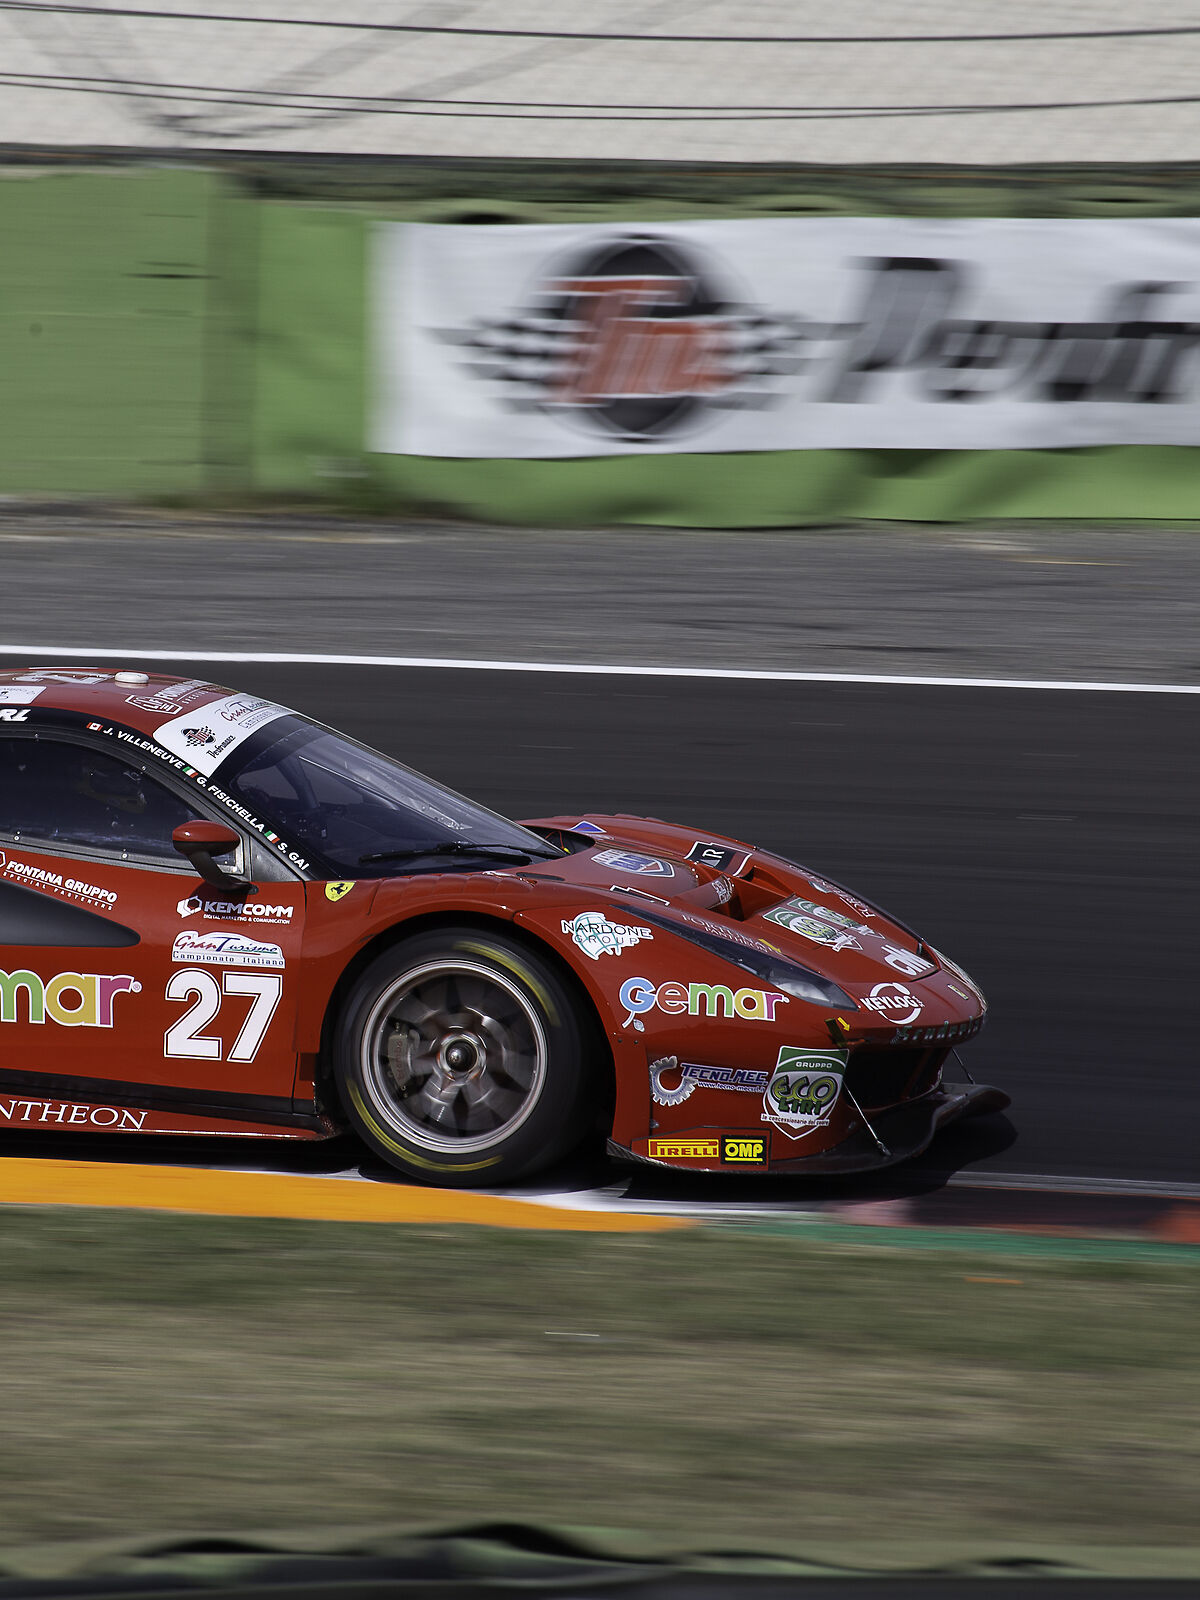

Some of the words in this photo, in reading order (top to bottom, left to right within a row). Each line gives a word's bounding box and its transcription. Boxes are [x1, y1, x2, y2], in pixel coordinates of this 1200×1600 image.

[103, 727, 114, 736] J.
[117, 730, 185, 769] VILLENEUVE
[196, 776, 207, 787] G.
[207, 785, 265, 832] FISICHELLA
[277, 842, 288, 853] S.
[288, 852, 310, 871] GAI
[6, 861, 63, 886] FONTANA
[64, 878, 118, 903] GRUPPO
[3, 871, 46, 889] SPECIAL
[53, 887, 113, 911] FASTENERS
[204, 901, 294, 918] KEMCOMM
[563, 921, 651, 938] NARDONE
[174, 935, 217, 950] Gran
[210, 936, 278, 952] Turismo
[574, 935, 638, 944] GROUP
[173, 951, 235, 962] Campionato
[243, 957, 284, 966] Italiano
[860, 996, 919, 1011] KEYLOG
[163, 967, 284, 1064] 27
[770, 1075, 838, 1107] ECO
[778, 1097, 822, 1115] LIRI
[651, 1140, 717, 1157] PIRELLI
[725, 1143, 763, 1158] OMP
